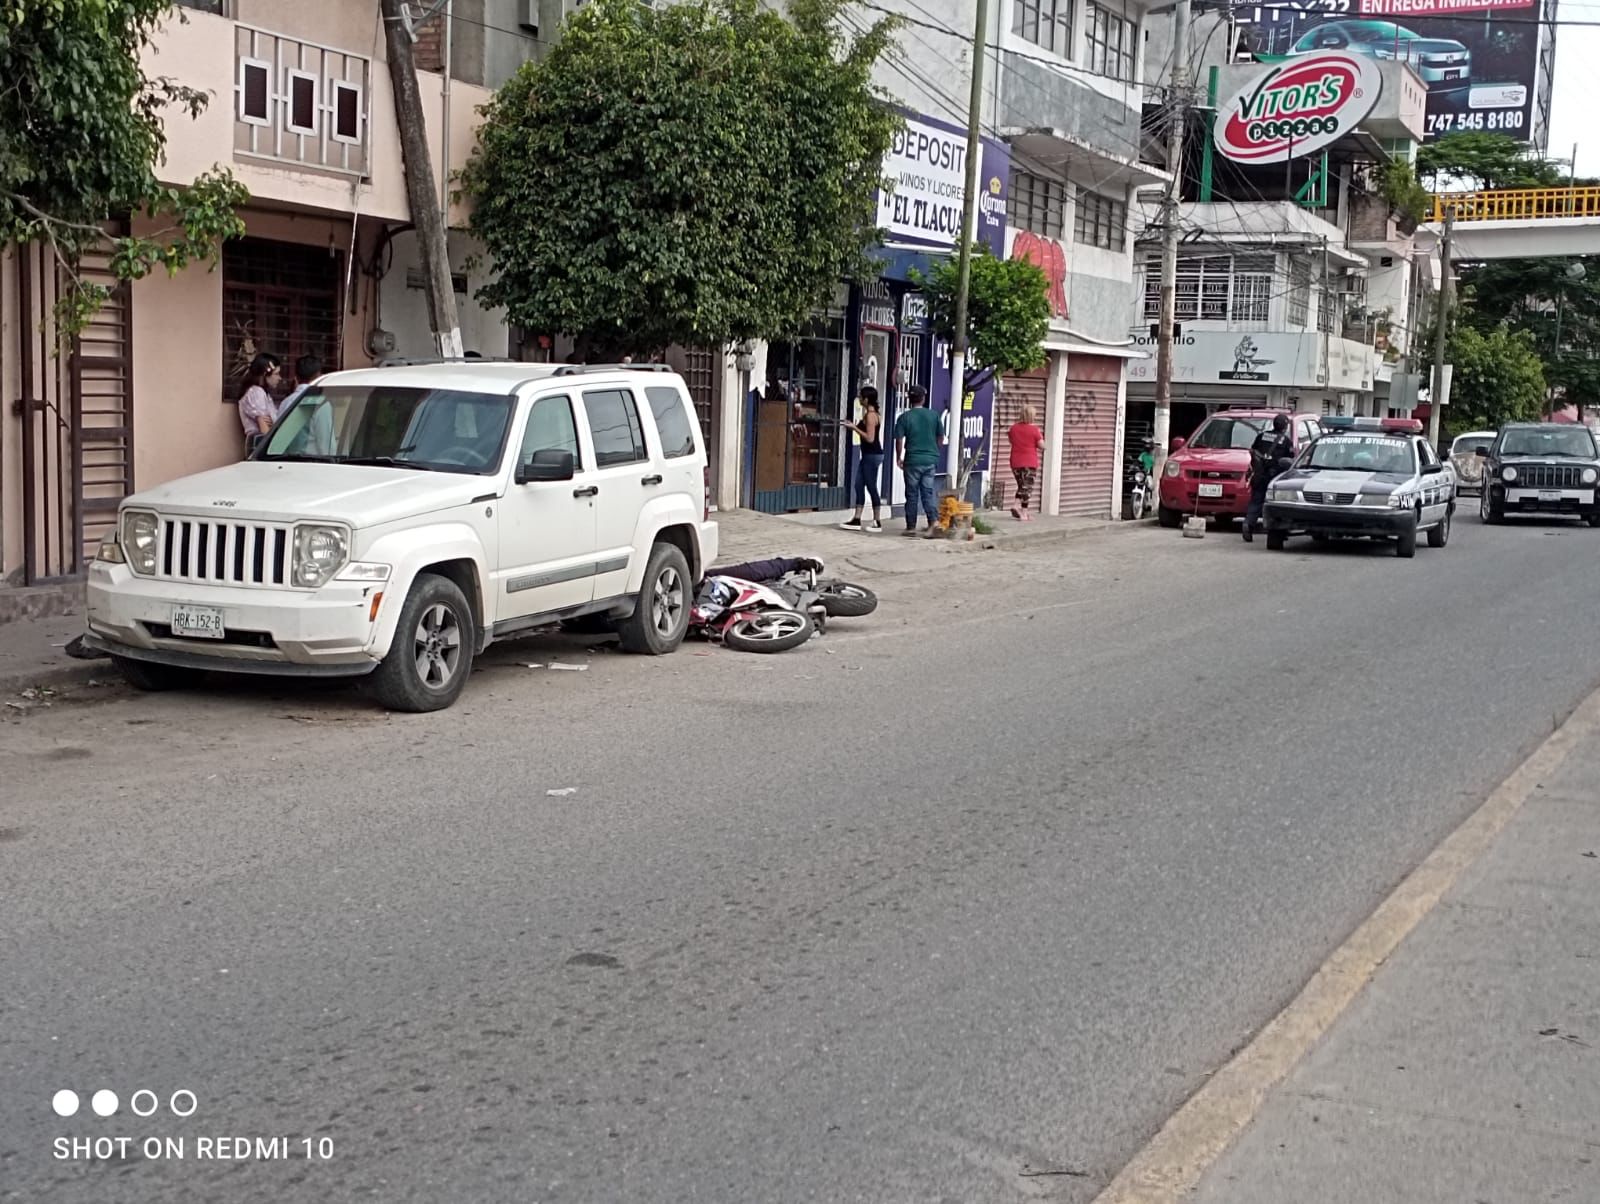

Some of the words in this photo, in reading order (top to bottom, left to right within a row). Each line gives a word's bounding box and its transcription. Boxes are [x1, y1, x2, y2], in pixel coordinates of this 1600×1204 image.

[1239, 67, 1344, 120] VITOR'S
[1251, 118, 1337, 141] pizzas
[1428, 114, 1454, 131] 747
[1457, 112, 1484, 130] 545
[1487, 111, 1523, 129] 8180
[892, 127, 966, 174] DEPOSIT
[900, 171, 925, 191] VINOS
[926, 178, 932, 192] Y
[913, 198, 965, 236] TLACUA
